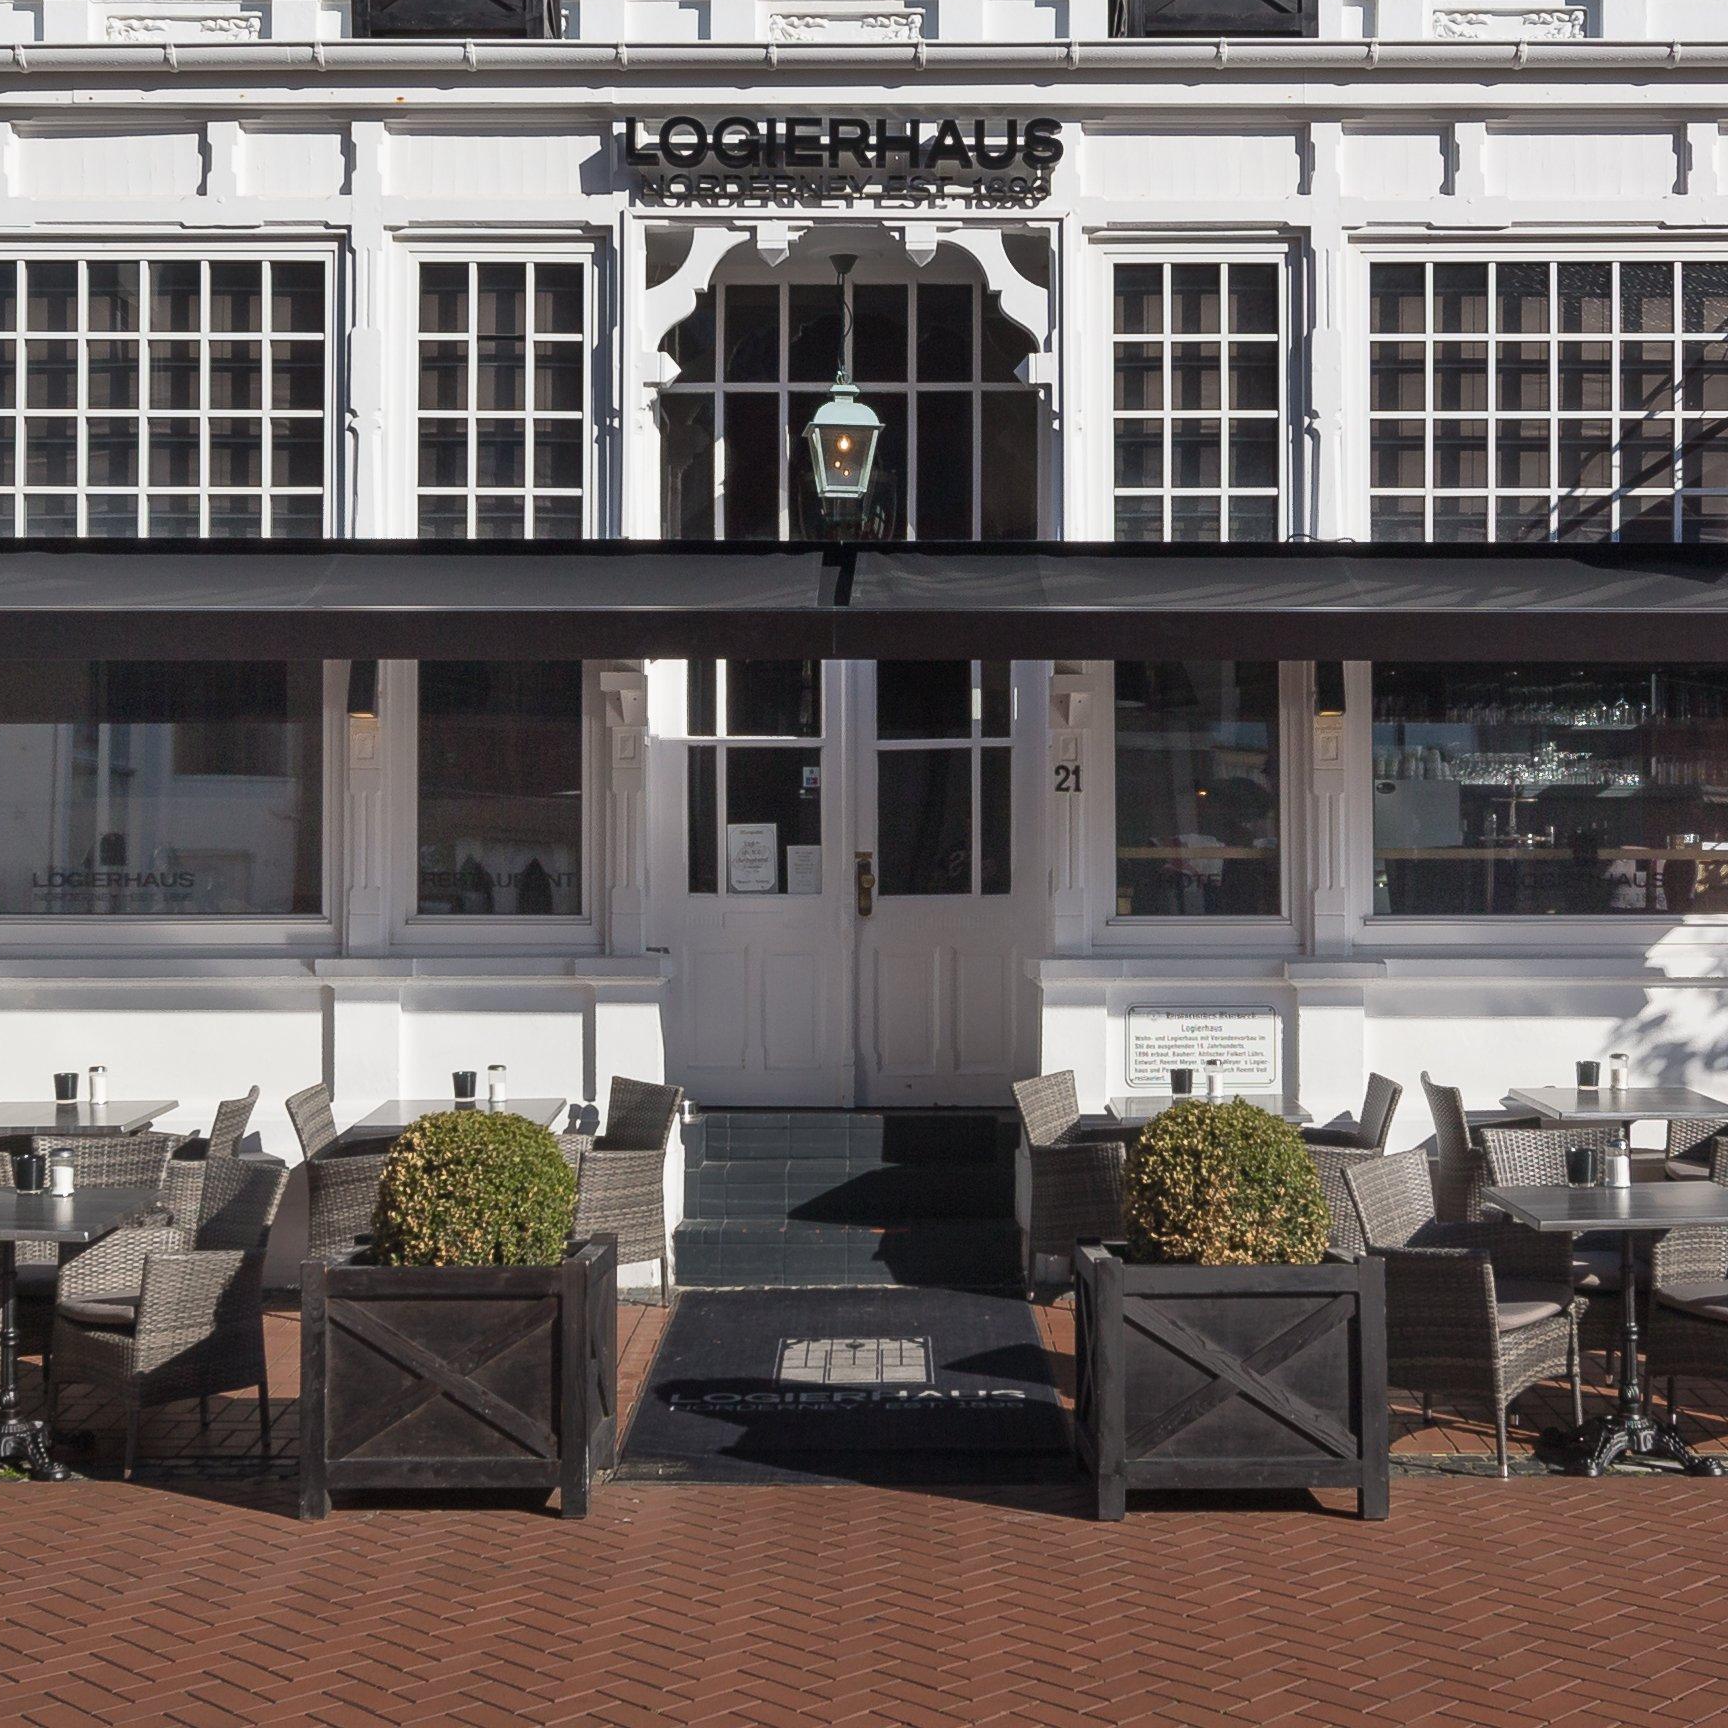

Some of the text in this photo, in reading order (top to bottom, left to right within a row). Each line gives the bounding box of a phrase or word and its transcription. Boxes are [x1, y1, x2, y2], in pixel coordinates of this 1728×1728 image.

[625, 116, 1064, 169] LOGIERHAUS
[642, 174, 873, 199] NORDERNEY
[1054, 765, 1083, 793] 21
[32, 872, 196, 888] LOGIERHAUS
[422, 872, 576, 888] RESTURNT
[1181, 1025, 1223, 1033] Logierhaus
[670, 1389, 1026, 1404] LOGIERHAUS
